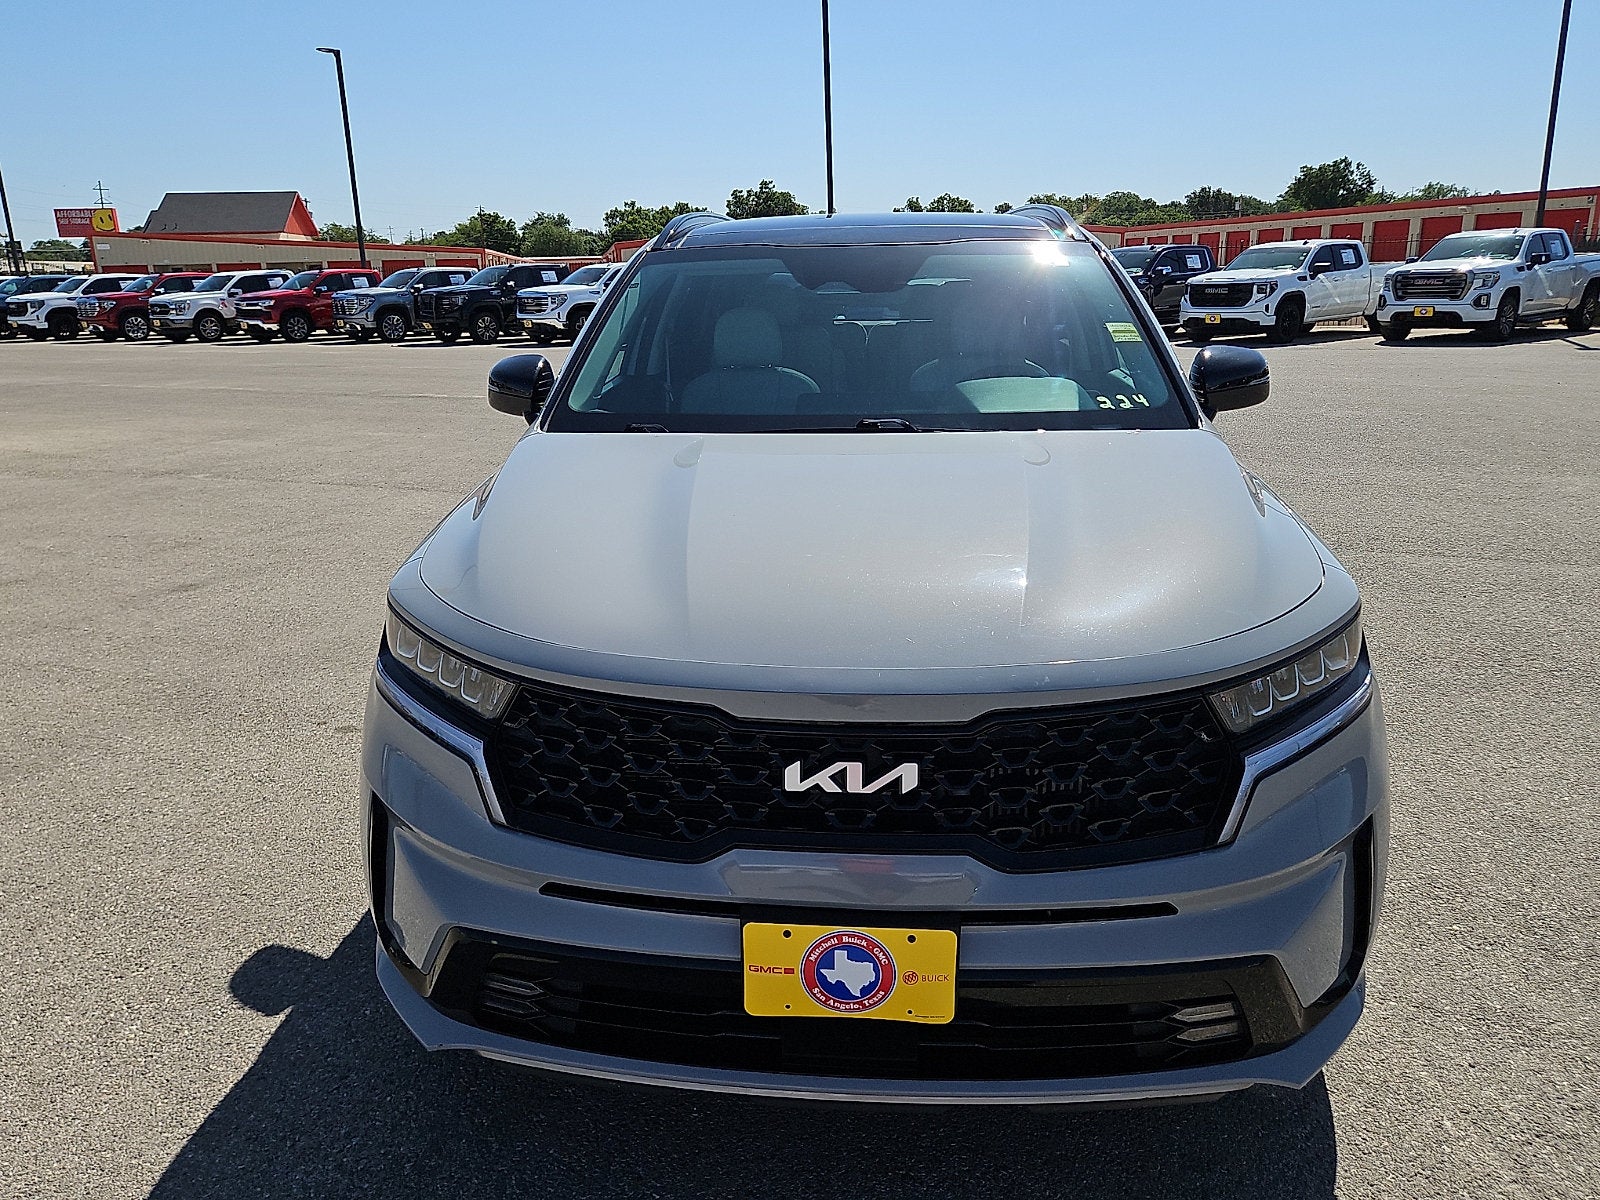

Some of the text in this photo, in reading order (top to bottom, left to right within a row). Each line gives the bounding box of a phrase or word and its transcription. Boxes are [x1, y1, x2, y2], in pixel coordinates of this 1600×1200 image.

[784, 760, 919, 795] KIA
[808, 936, 839, 962] Mitchell
[841, 935, 868, 947] Buick
[873, 947, 889, 966] GMC
[748, 964, 783, 975] GMC
[921, 973, 951, 983] BUICK
[812, 987, 885, 1010] San Angelo, Texas
